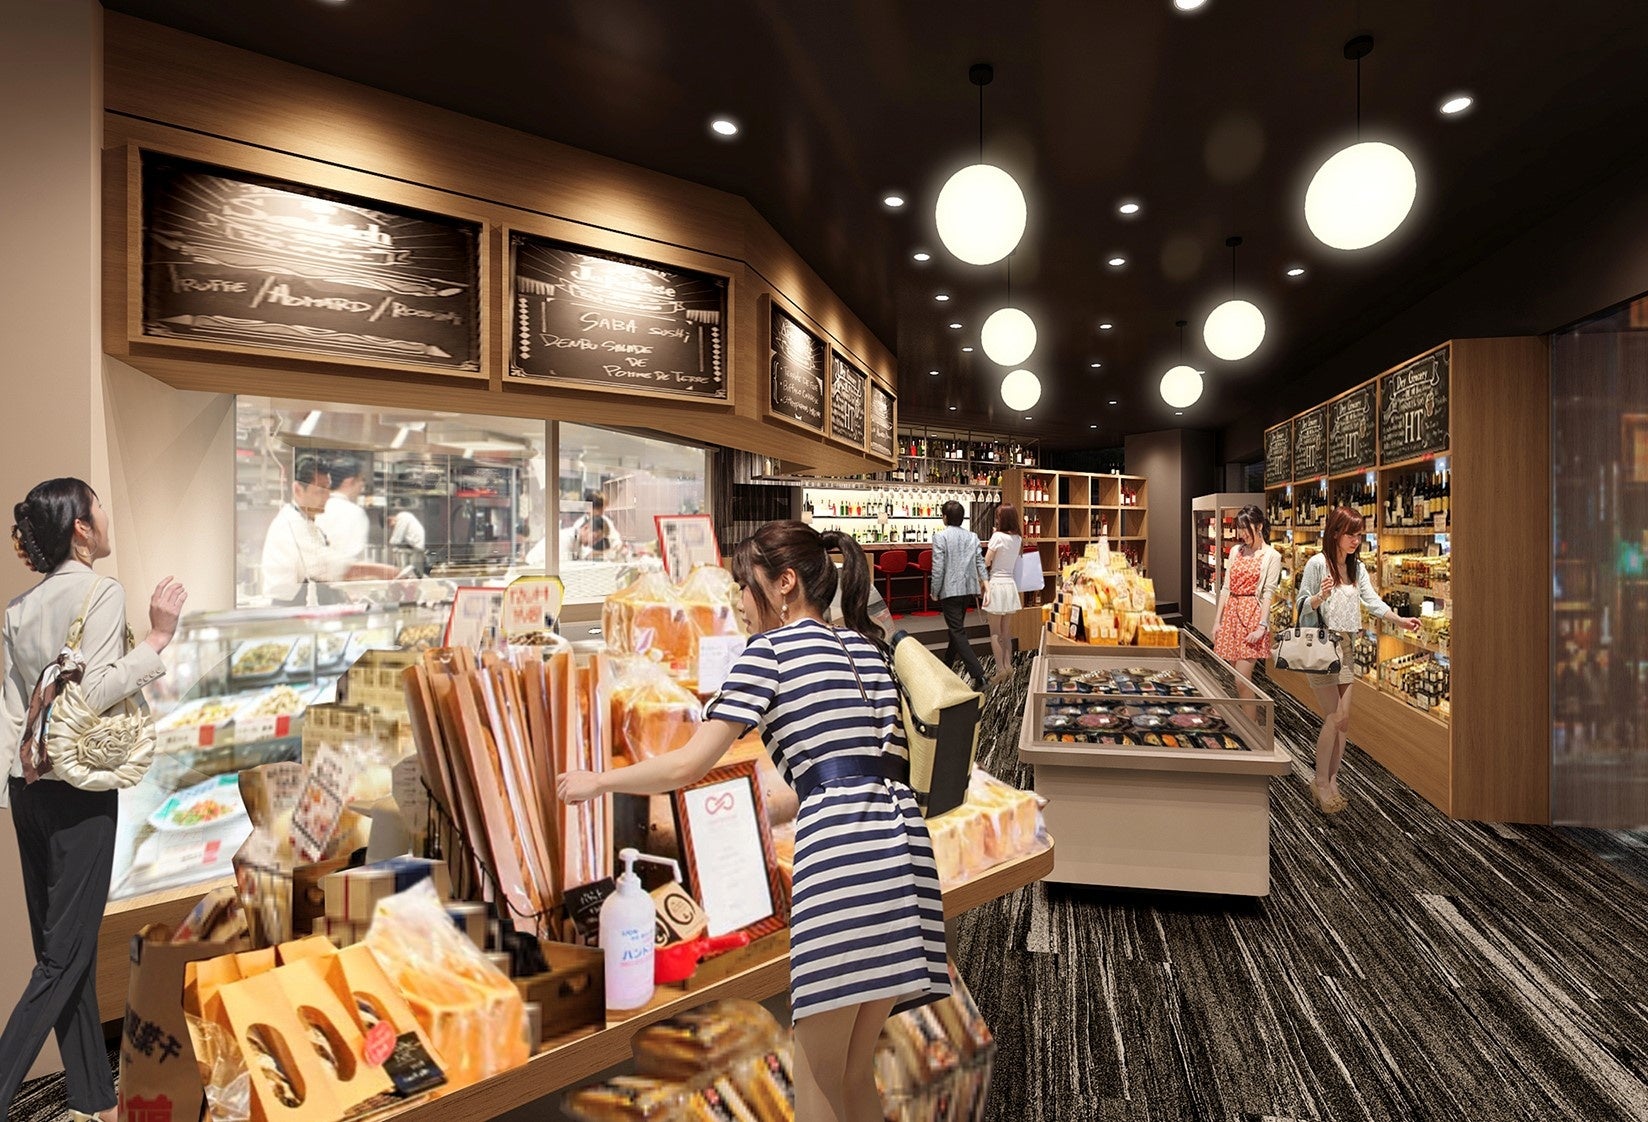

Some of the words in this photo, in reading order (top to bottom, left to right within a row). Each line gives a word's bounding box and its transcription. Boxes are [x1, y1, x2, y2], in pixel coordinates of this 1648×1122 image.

[579, 312, 638, 334] SABA
[624, 356, 649, 368] DE
[1405, 408, 1424, 444] HT
[1345, 431, 1359, 459] HT
